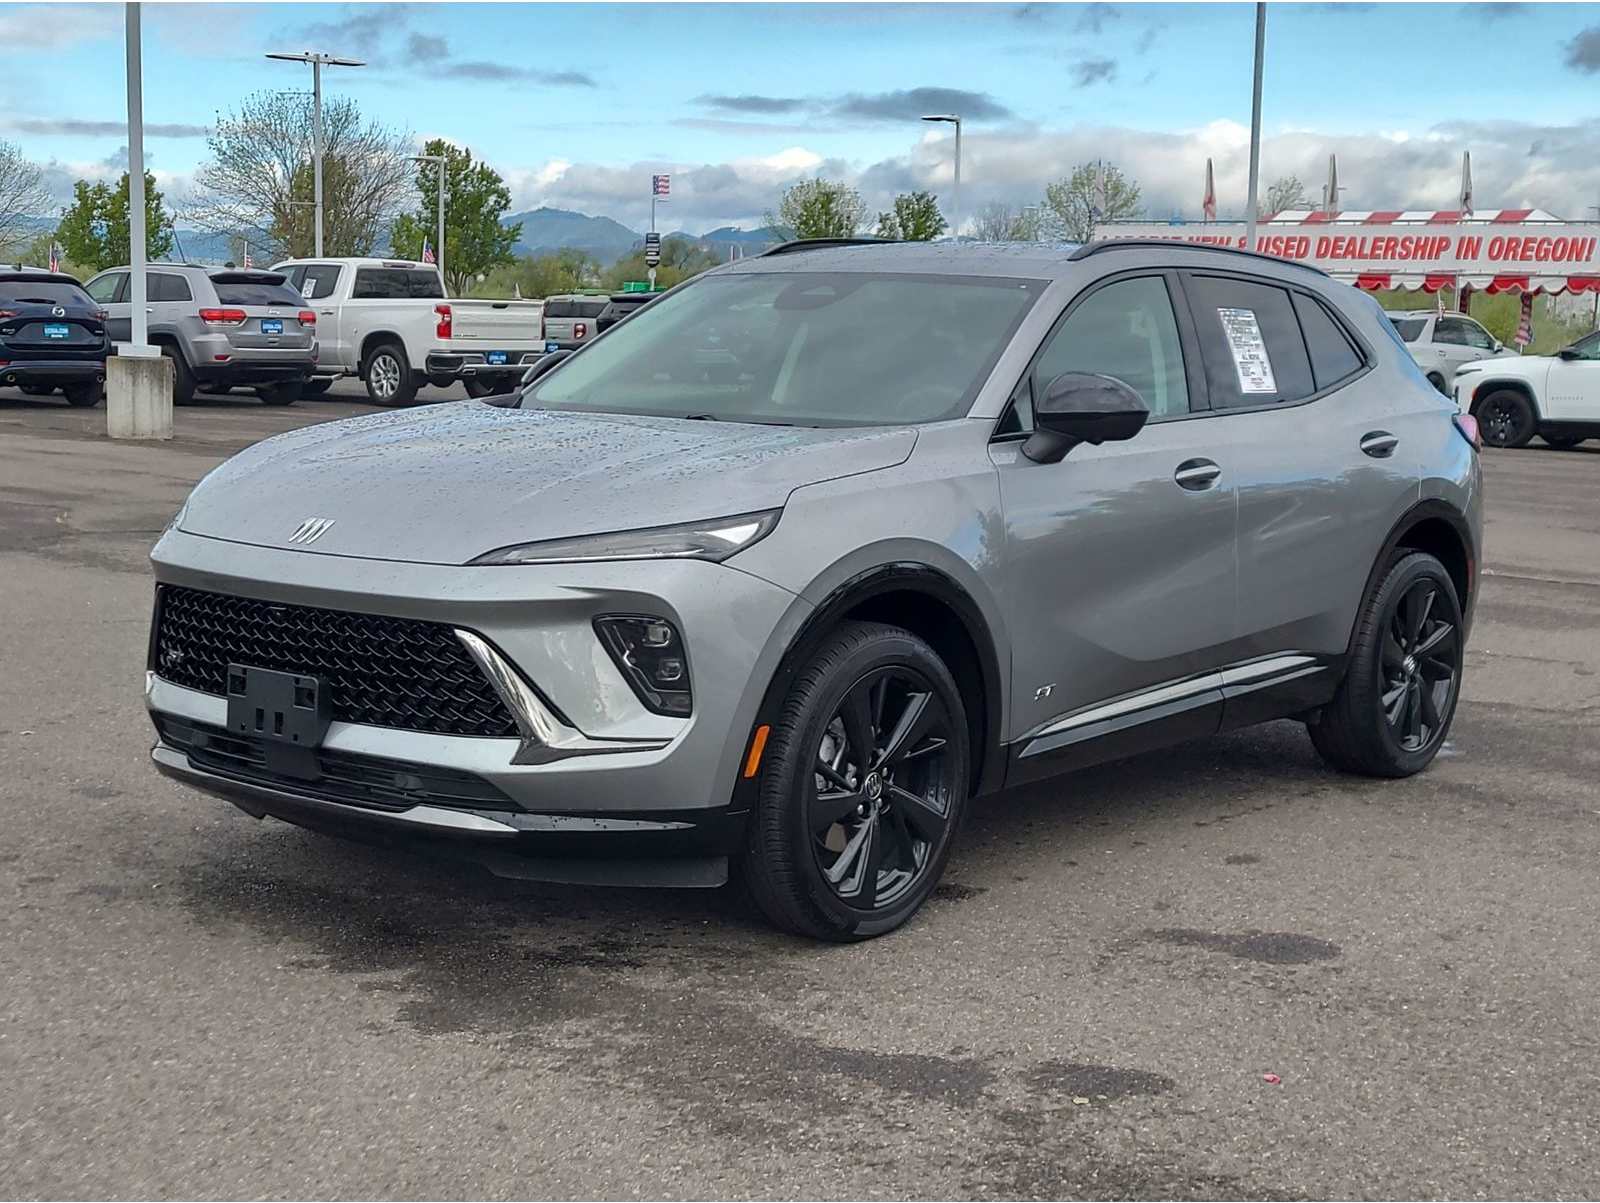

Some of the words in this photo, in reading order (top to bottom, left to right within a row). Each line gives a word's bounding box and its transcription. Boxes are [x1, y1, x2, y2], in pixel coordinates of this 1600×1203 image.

[1256, 236, 1311, 259] USED
[1316, 236, 1452, 260] DEALERSHIP
[1455, 236, 1482, 260] IN
[1488, 237, 1597, 262] OREGON!
